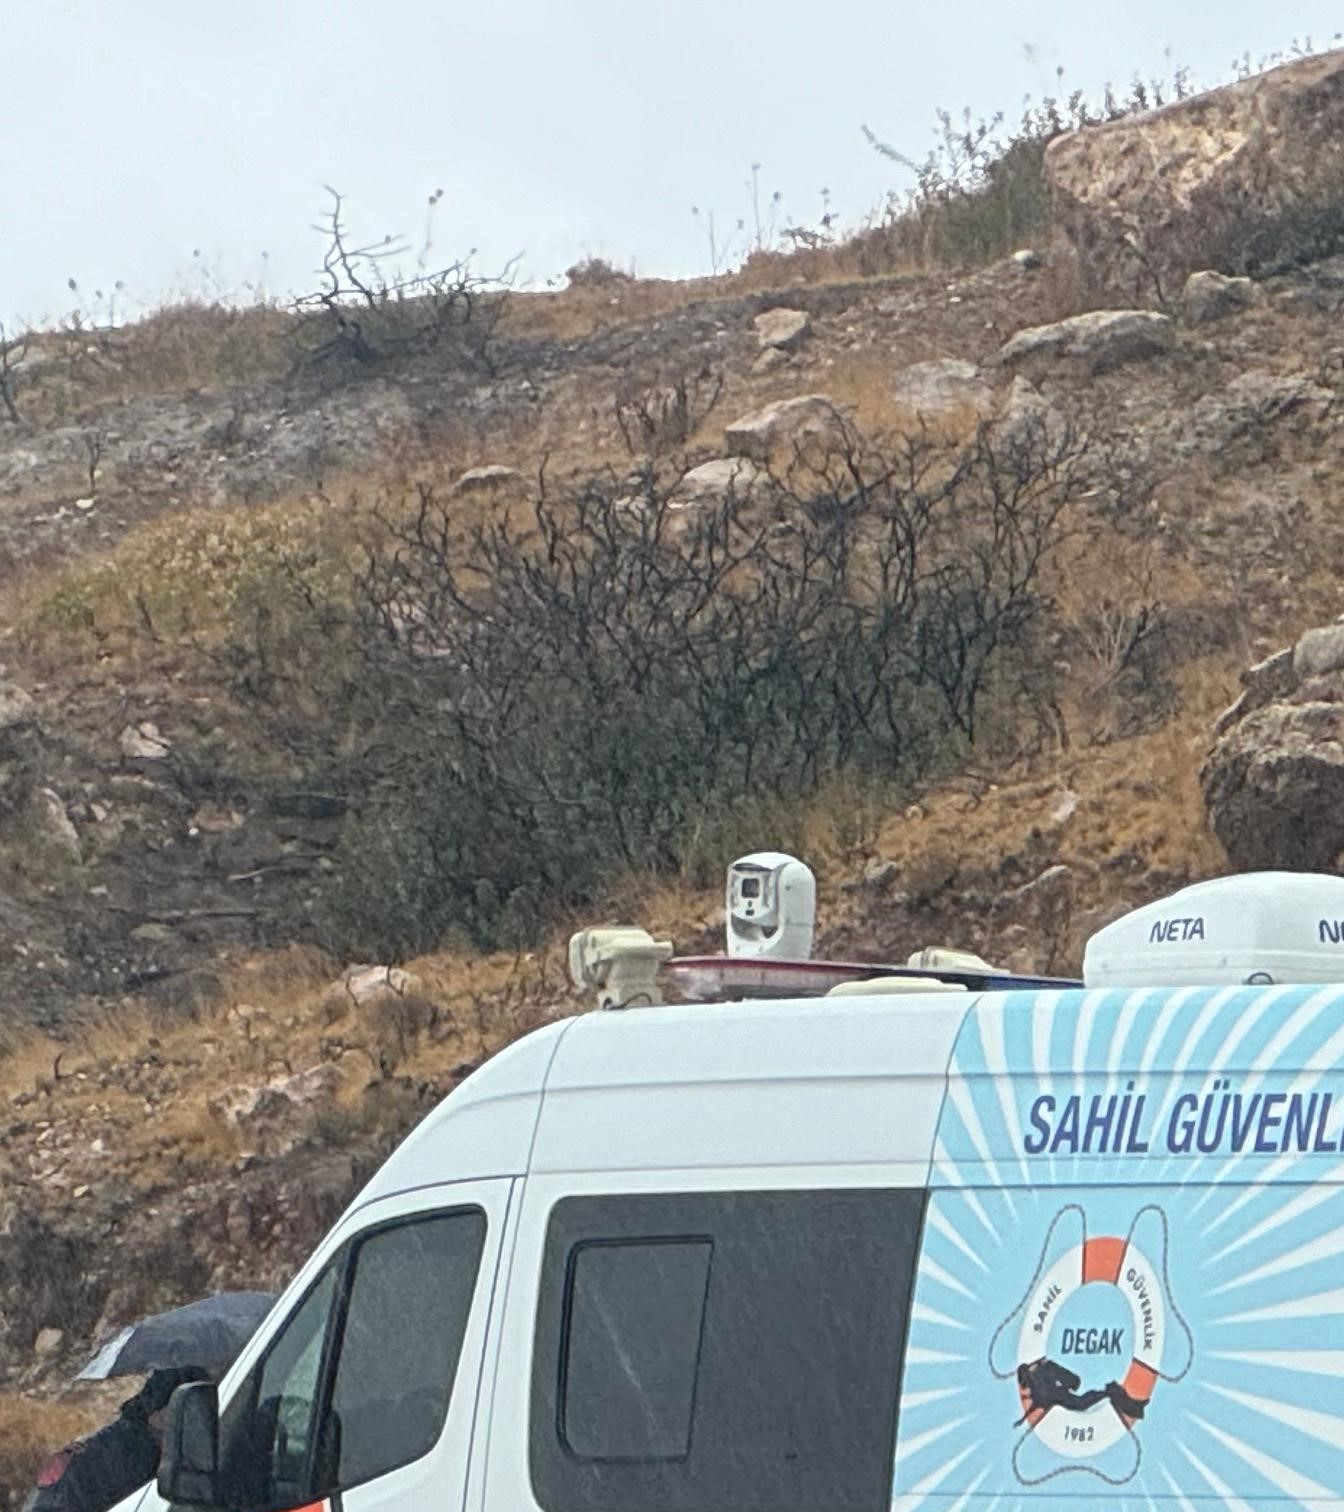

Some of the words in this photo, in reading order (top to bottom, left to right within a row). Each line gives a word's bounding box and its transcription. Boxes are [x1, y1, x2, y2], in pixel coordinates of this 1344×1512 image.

[1149, 918, 1205, 943] NETA
[1023, 1081, 1149, 1154] SAHİL
[1033, 1284, 1063, 1333] SAHİL
[1126, 1268, 1156, 1351] GÜVENLİK
[1061, 1328, 1124, 1355] DEGAK
